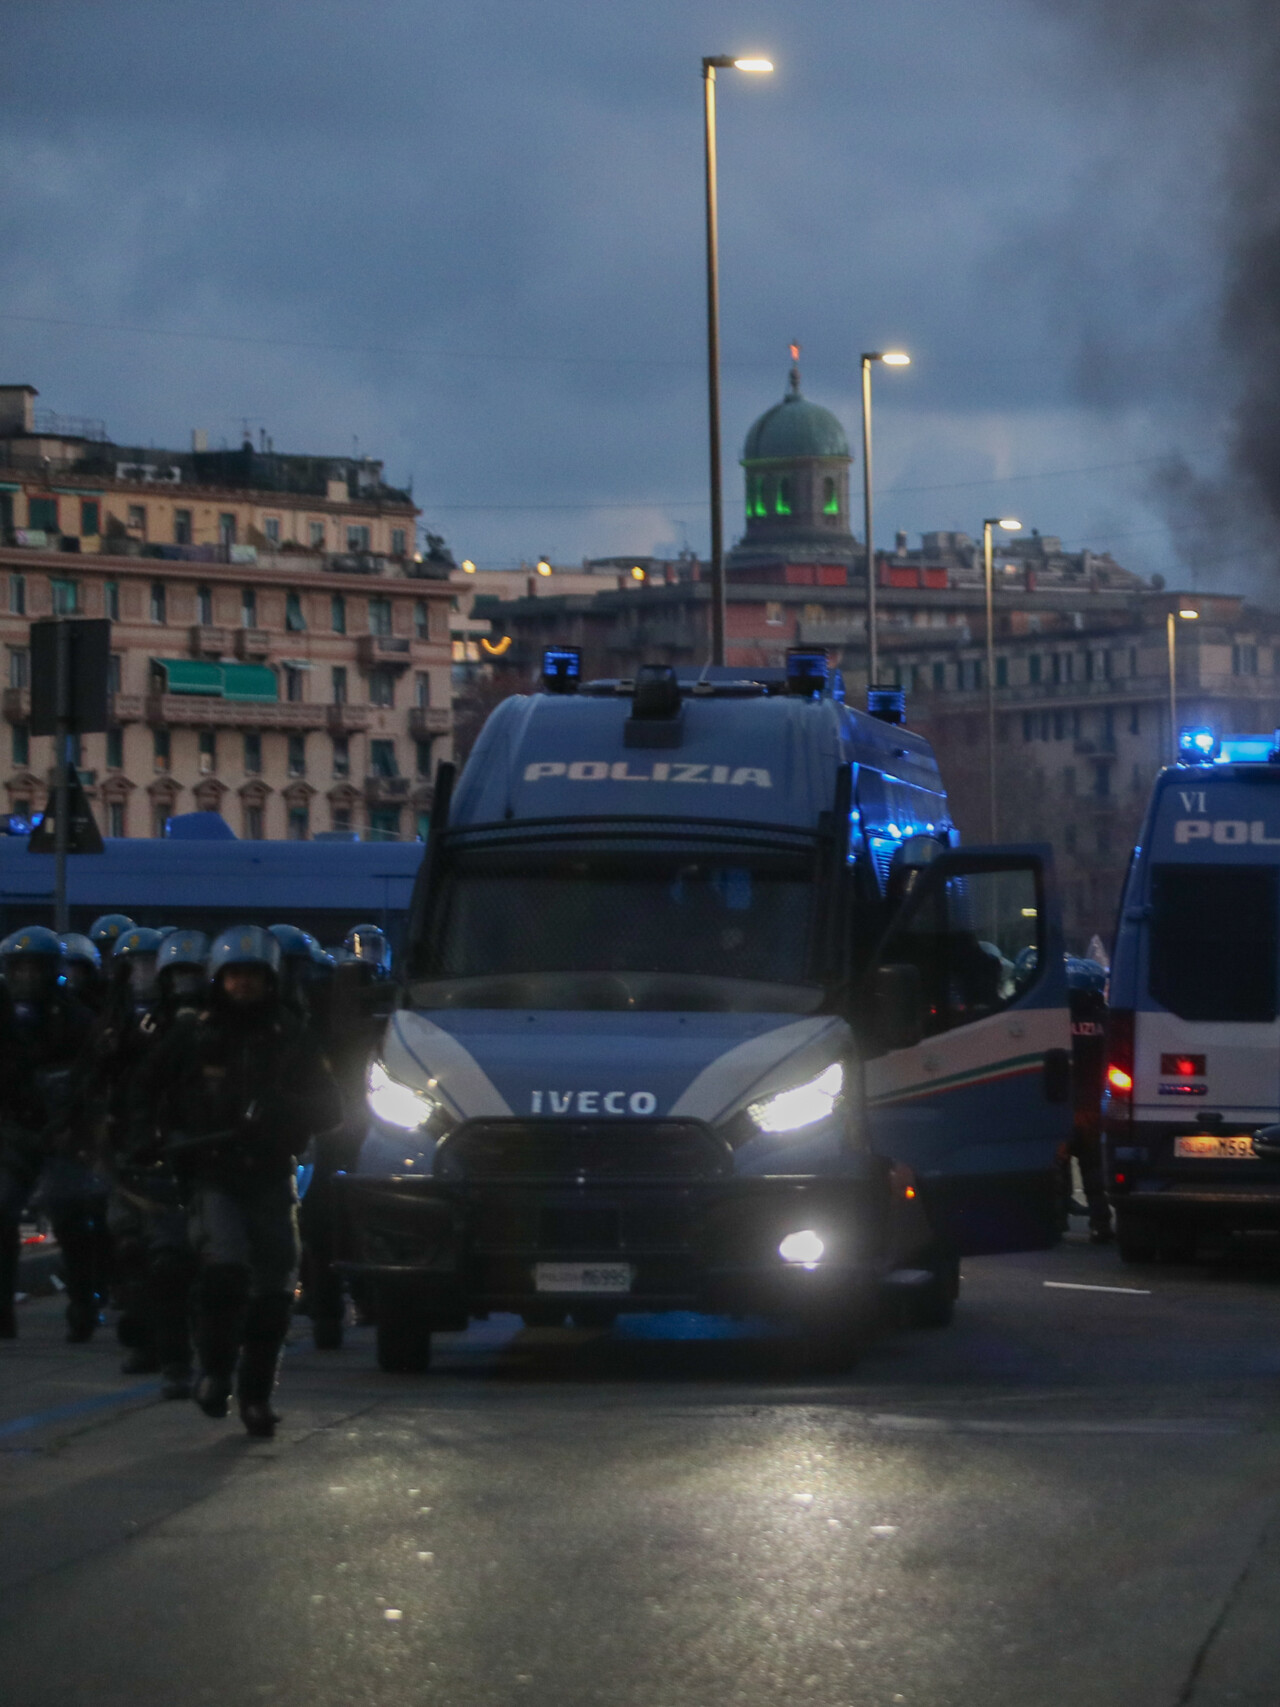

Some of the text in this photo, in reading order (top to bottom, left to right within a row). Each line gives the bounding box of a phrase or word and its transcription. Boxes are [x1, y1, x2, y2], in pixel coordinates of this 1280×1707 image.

[523, 761, 773, 788] POLIZIA
[1178, 791, 1208, 813] VI
[531, 1090, 658, 1115] IVECO
